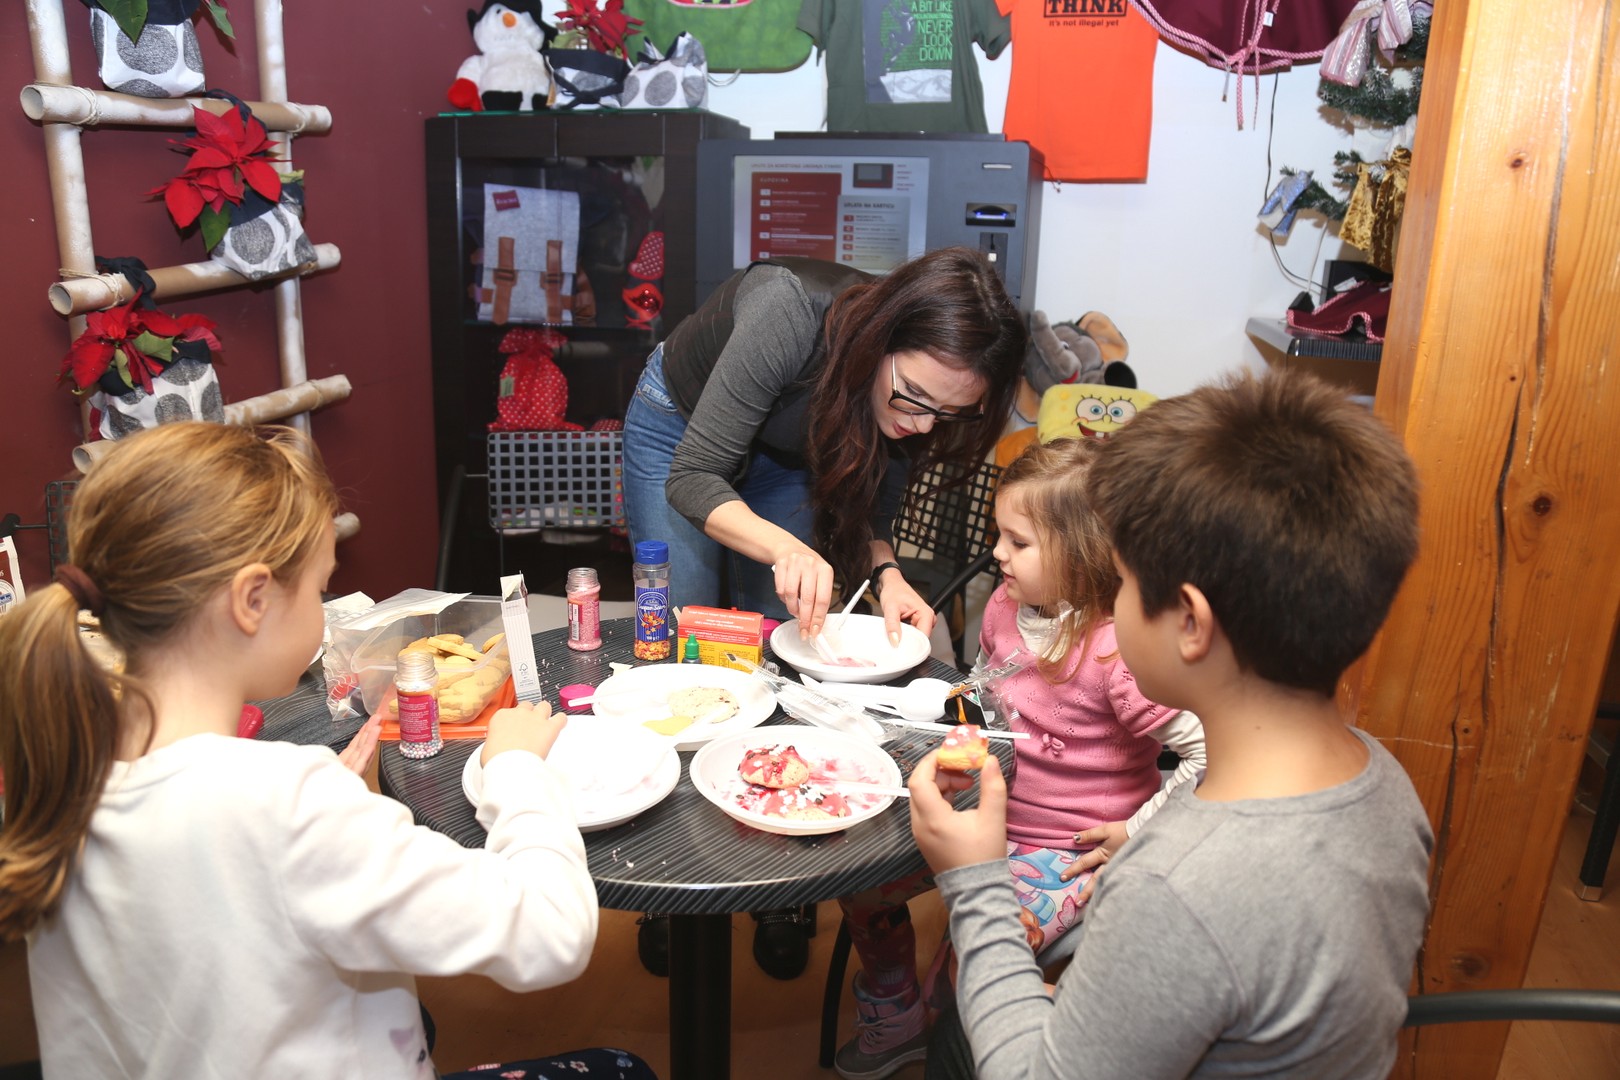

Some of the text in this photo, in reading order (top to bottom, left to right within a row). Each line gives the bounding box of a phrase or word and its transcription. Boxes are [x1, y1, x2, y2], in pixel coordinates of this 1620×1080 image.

[911, 1, 953, 12] A BIT LIKE
[1048, 0, 1123, 13] THINK
[917, 20, 953, 33] NEVER
[924, 33, 953, 47] LOOK
[920, 46, 952, 61] DOWN
